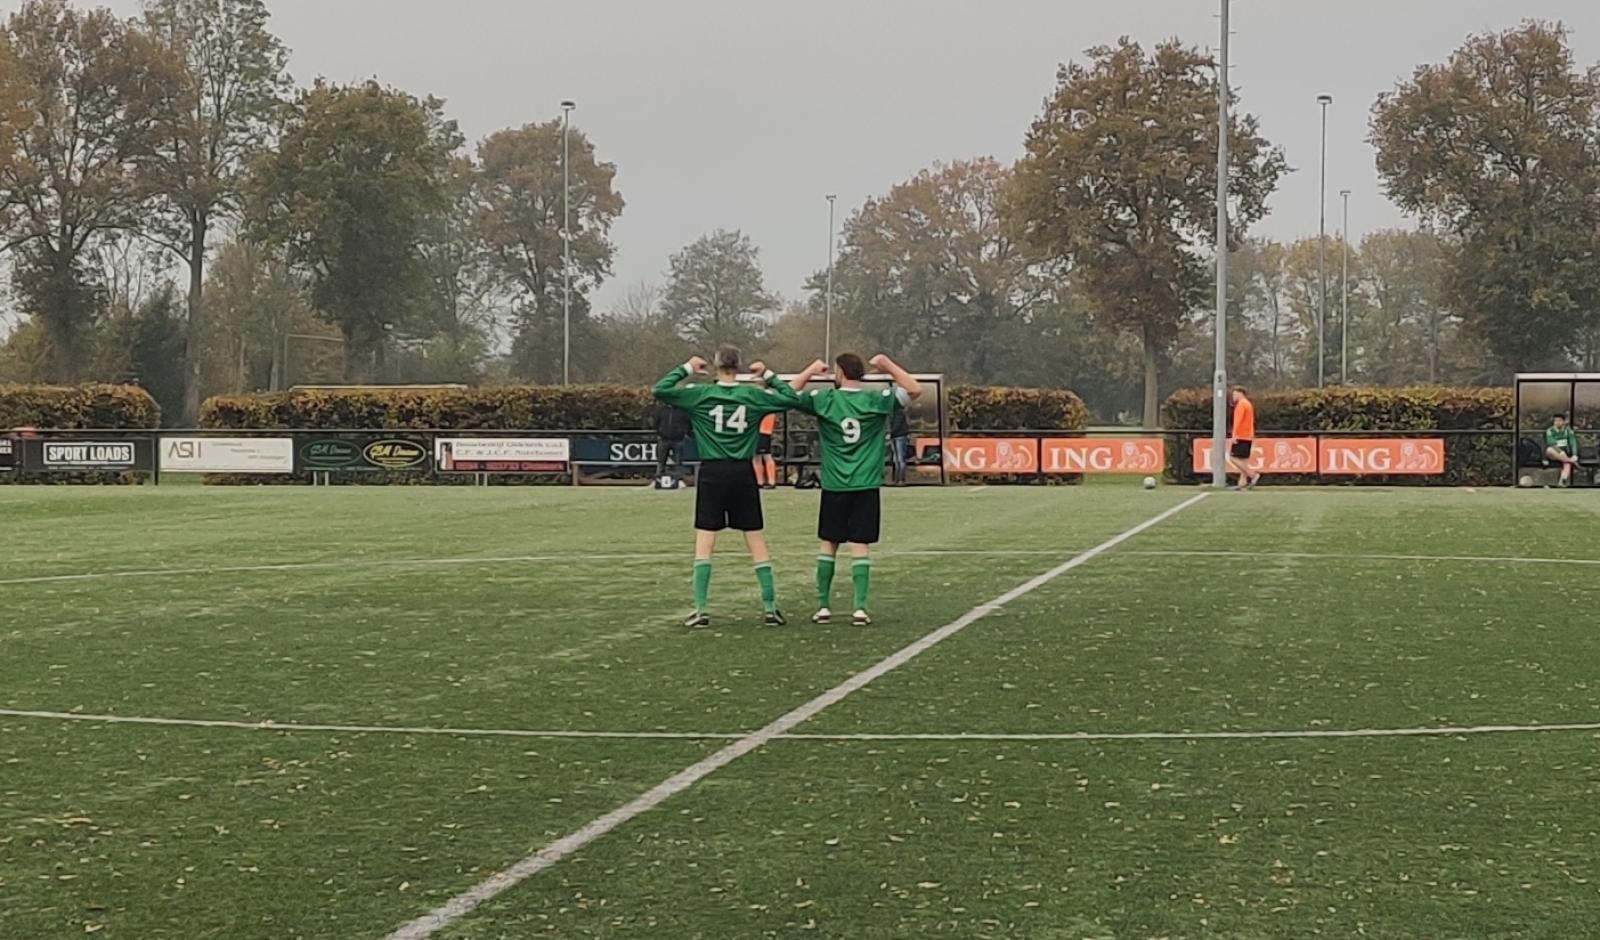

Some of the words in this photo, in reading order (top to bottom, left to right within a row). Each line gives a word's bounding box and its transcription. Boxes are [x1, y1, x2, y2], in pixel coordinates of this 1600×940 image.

[708, 404, 748, 434] 14
[840, 416, 861, 444] 9
[48, 446, 88, 461] SPORT
[89, 446, 130, 461] LOADS
[944, 447, 986, 470] NG
[1049, 447, 1112, 470] ING
[1327, 448, 1391, 470] ING
